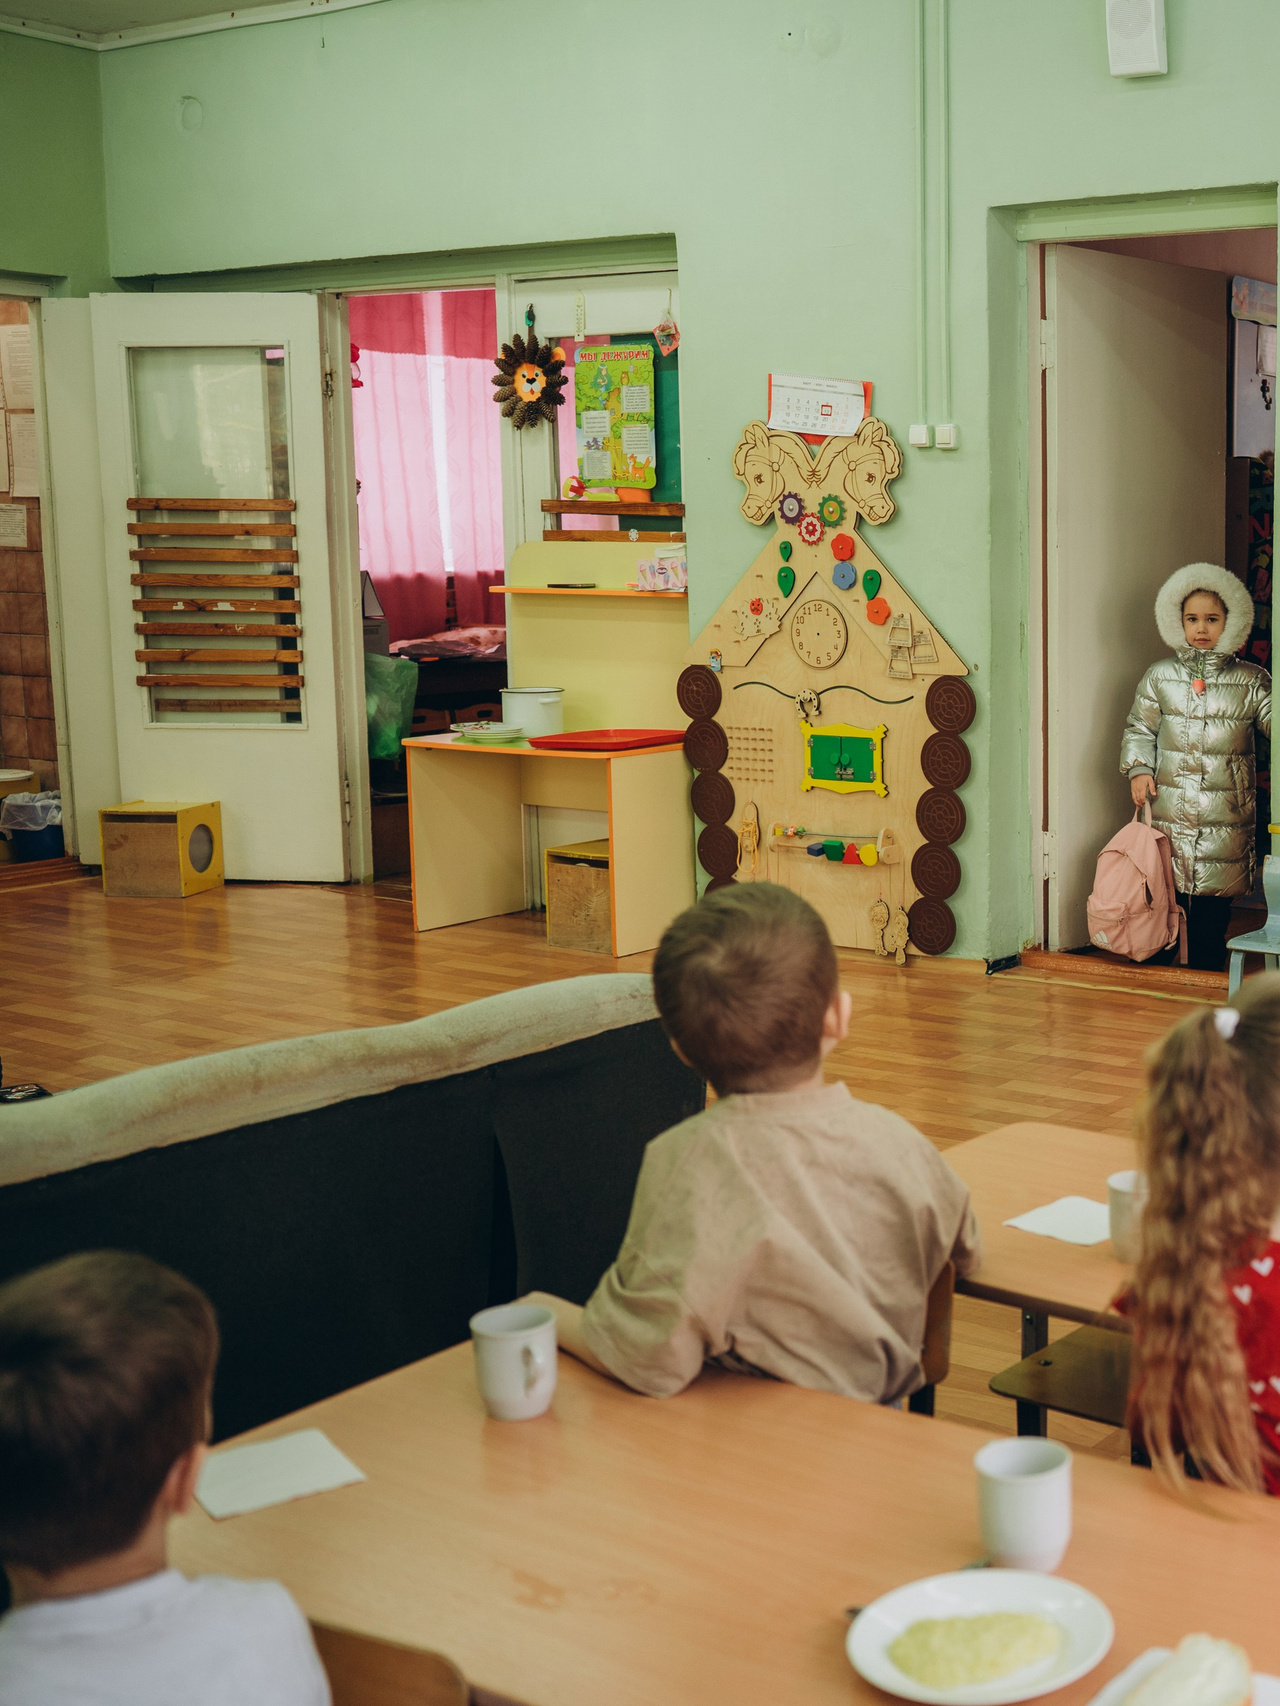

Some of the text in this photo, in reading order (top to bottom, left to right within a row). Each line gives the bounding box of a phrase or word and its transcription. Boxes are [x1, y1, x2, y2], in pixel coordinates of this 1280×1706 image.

[580, 350, 649, 362] МЫ ДЕЖУРИМ
[803, 607, 811, 615] 11
[814, 604, 822, 612] 12
[826, 608, 830, 616] 1
[796, 616, 804, 624] 10
[833, 618, 837, 626] 2
[837, 630, 841, 638] 3
[799, 642, 803, 650] 8
[806, 651, 811, 659] 7
[827, 652, 831, 660] 5
[816, 656, 821, 664] 6
